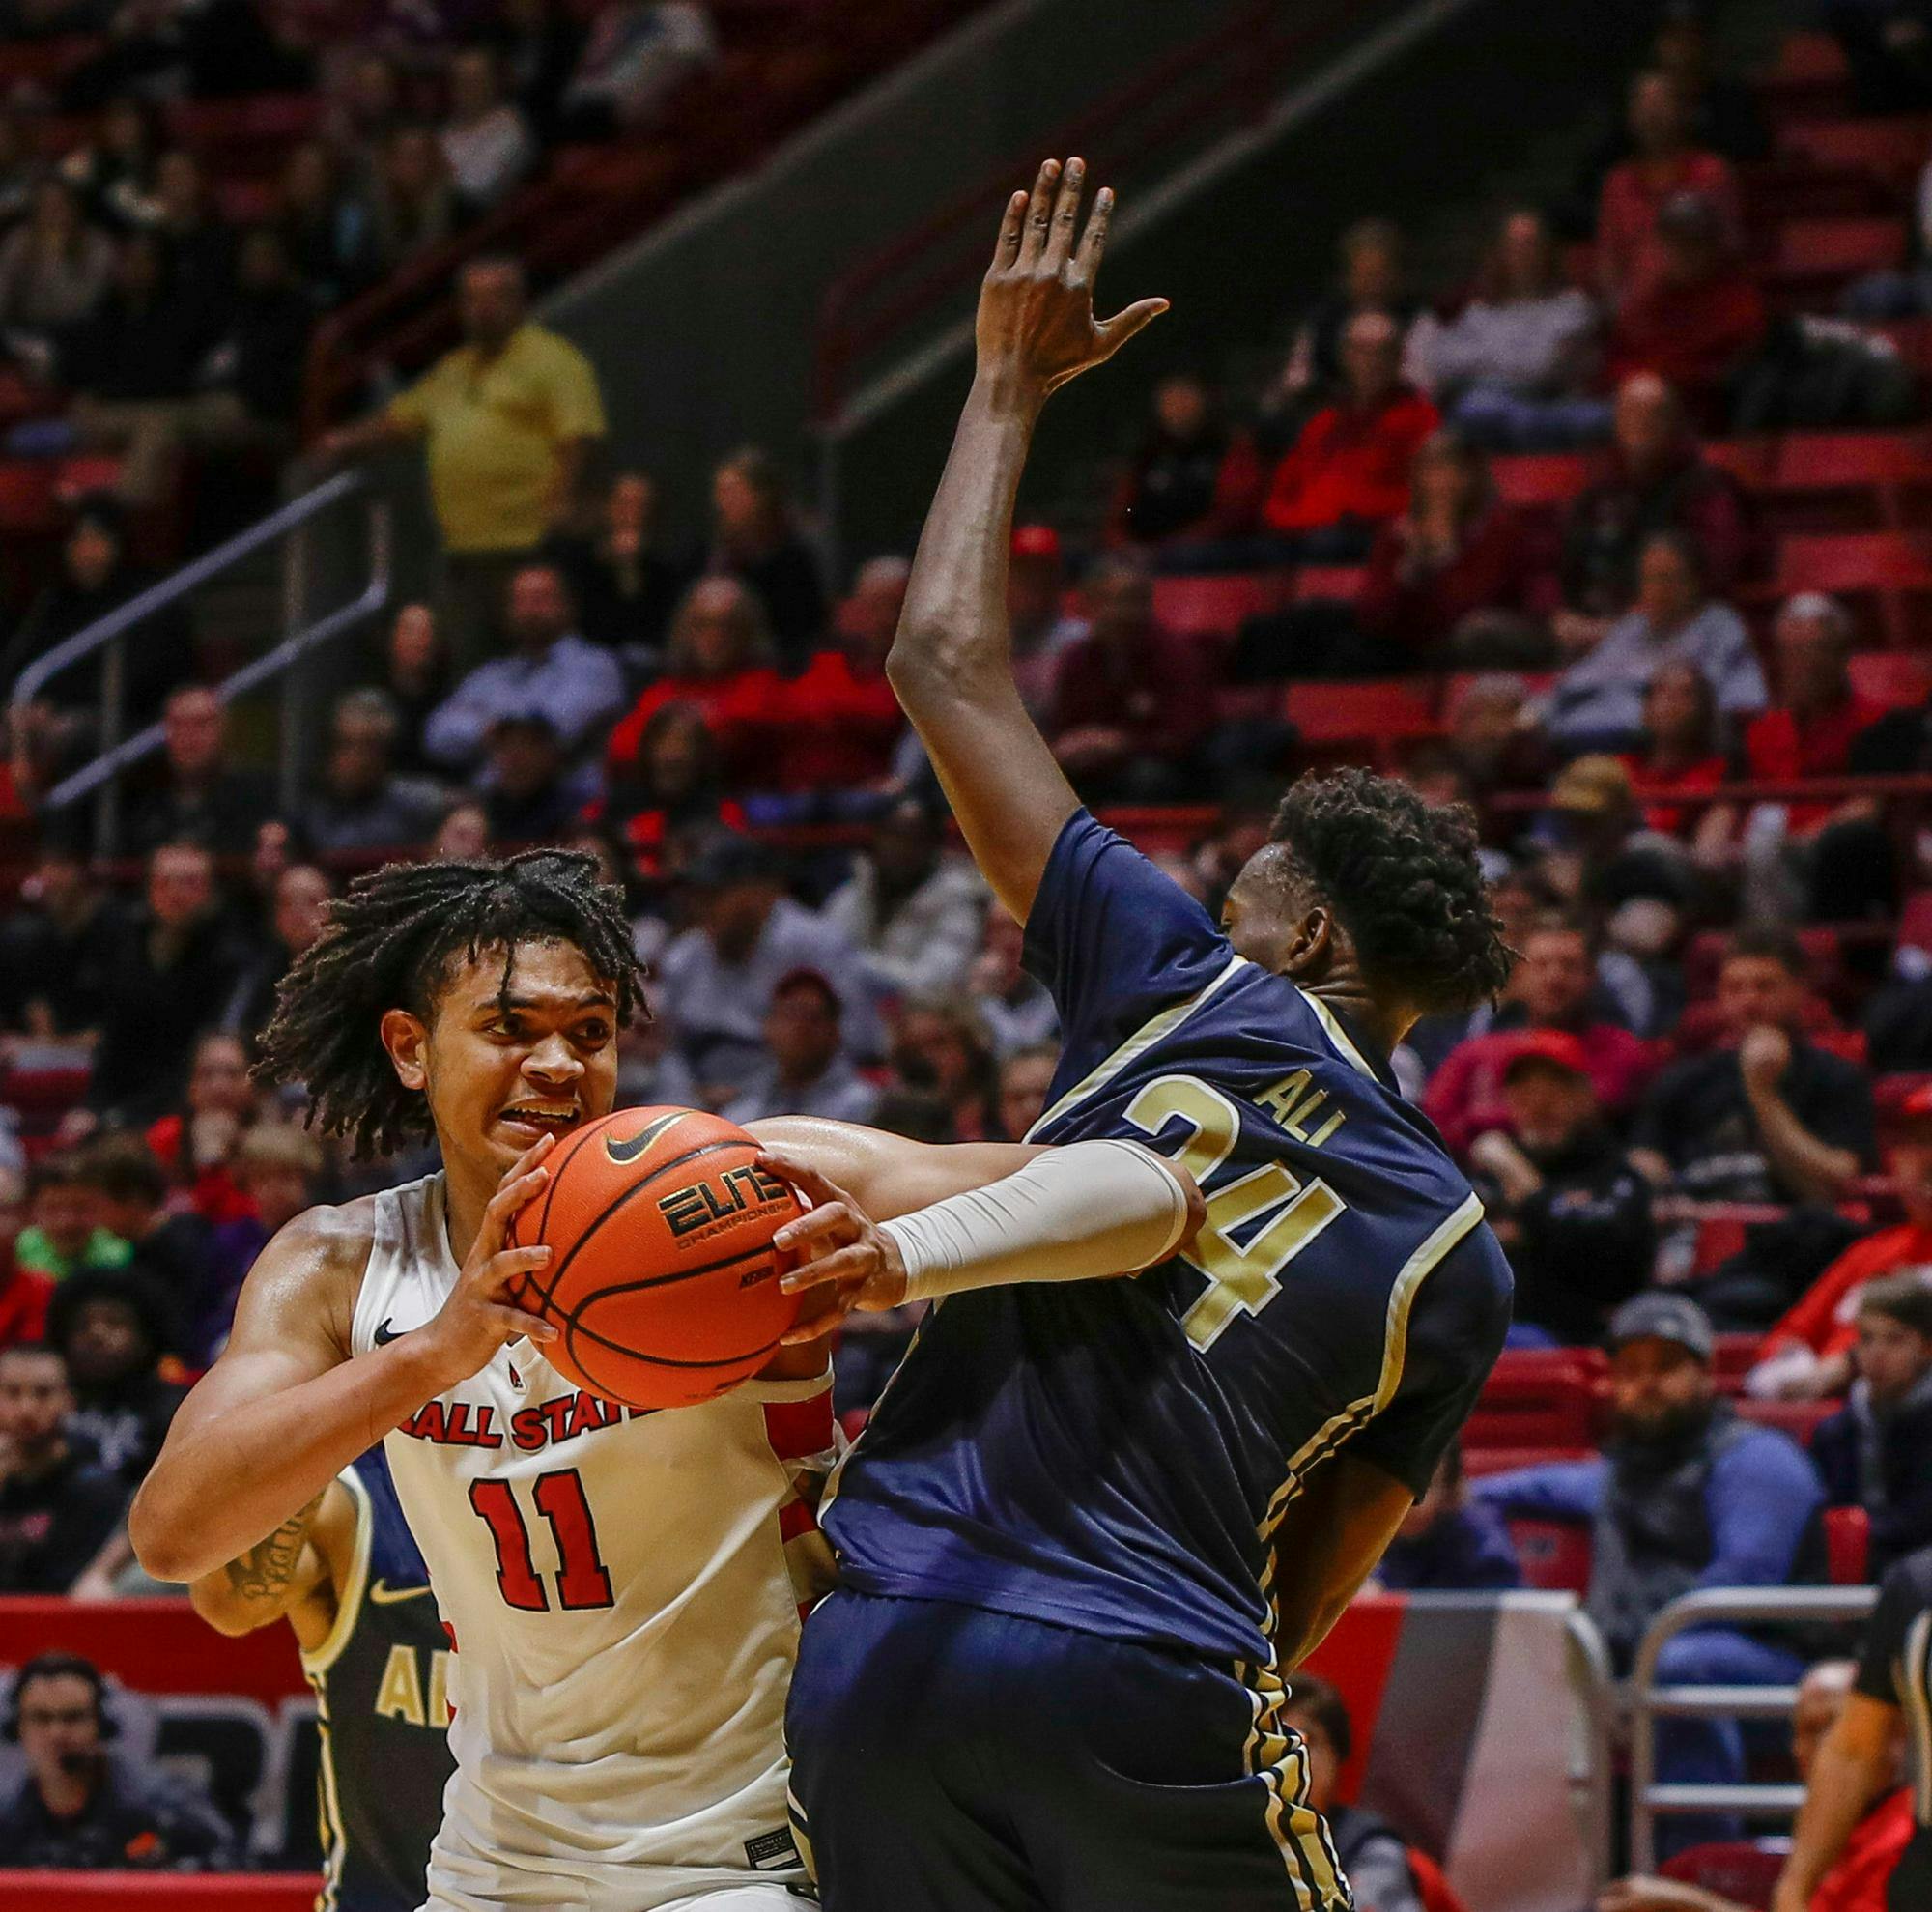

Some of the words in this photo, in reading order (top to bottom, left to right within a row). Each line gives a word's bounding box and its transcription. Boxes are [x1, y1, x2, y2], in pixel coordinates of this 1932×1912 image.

[1252, 1068, 1347, 1148] ALI
[657, 1164, 789, 1238] ELITE
[1122, 1074, 1347, 1354] 24
[397, 1400, 503, 1449] ALL
[511, 1389, 667, 1450] STA
[468, 1467, 615, 1612] 11
